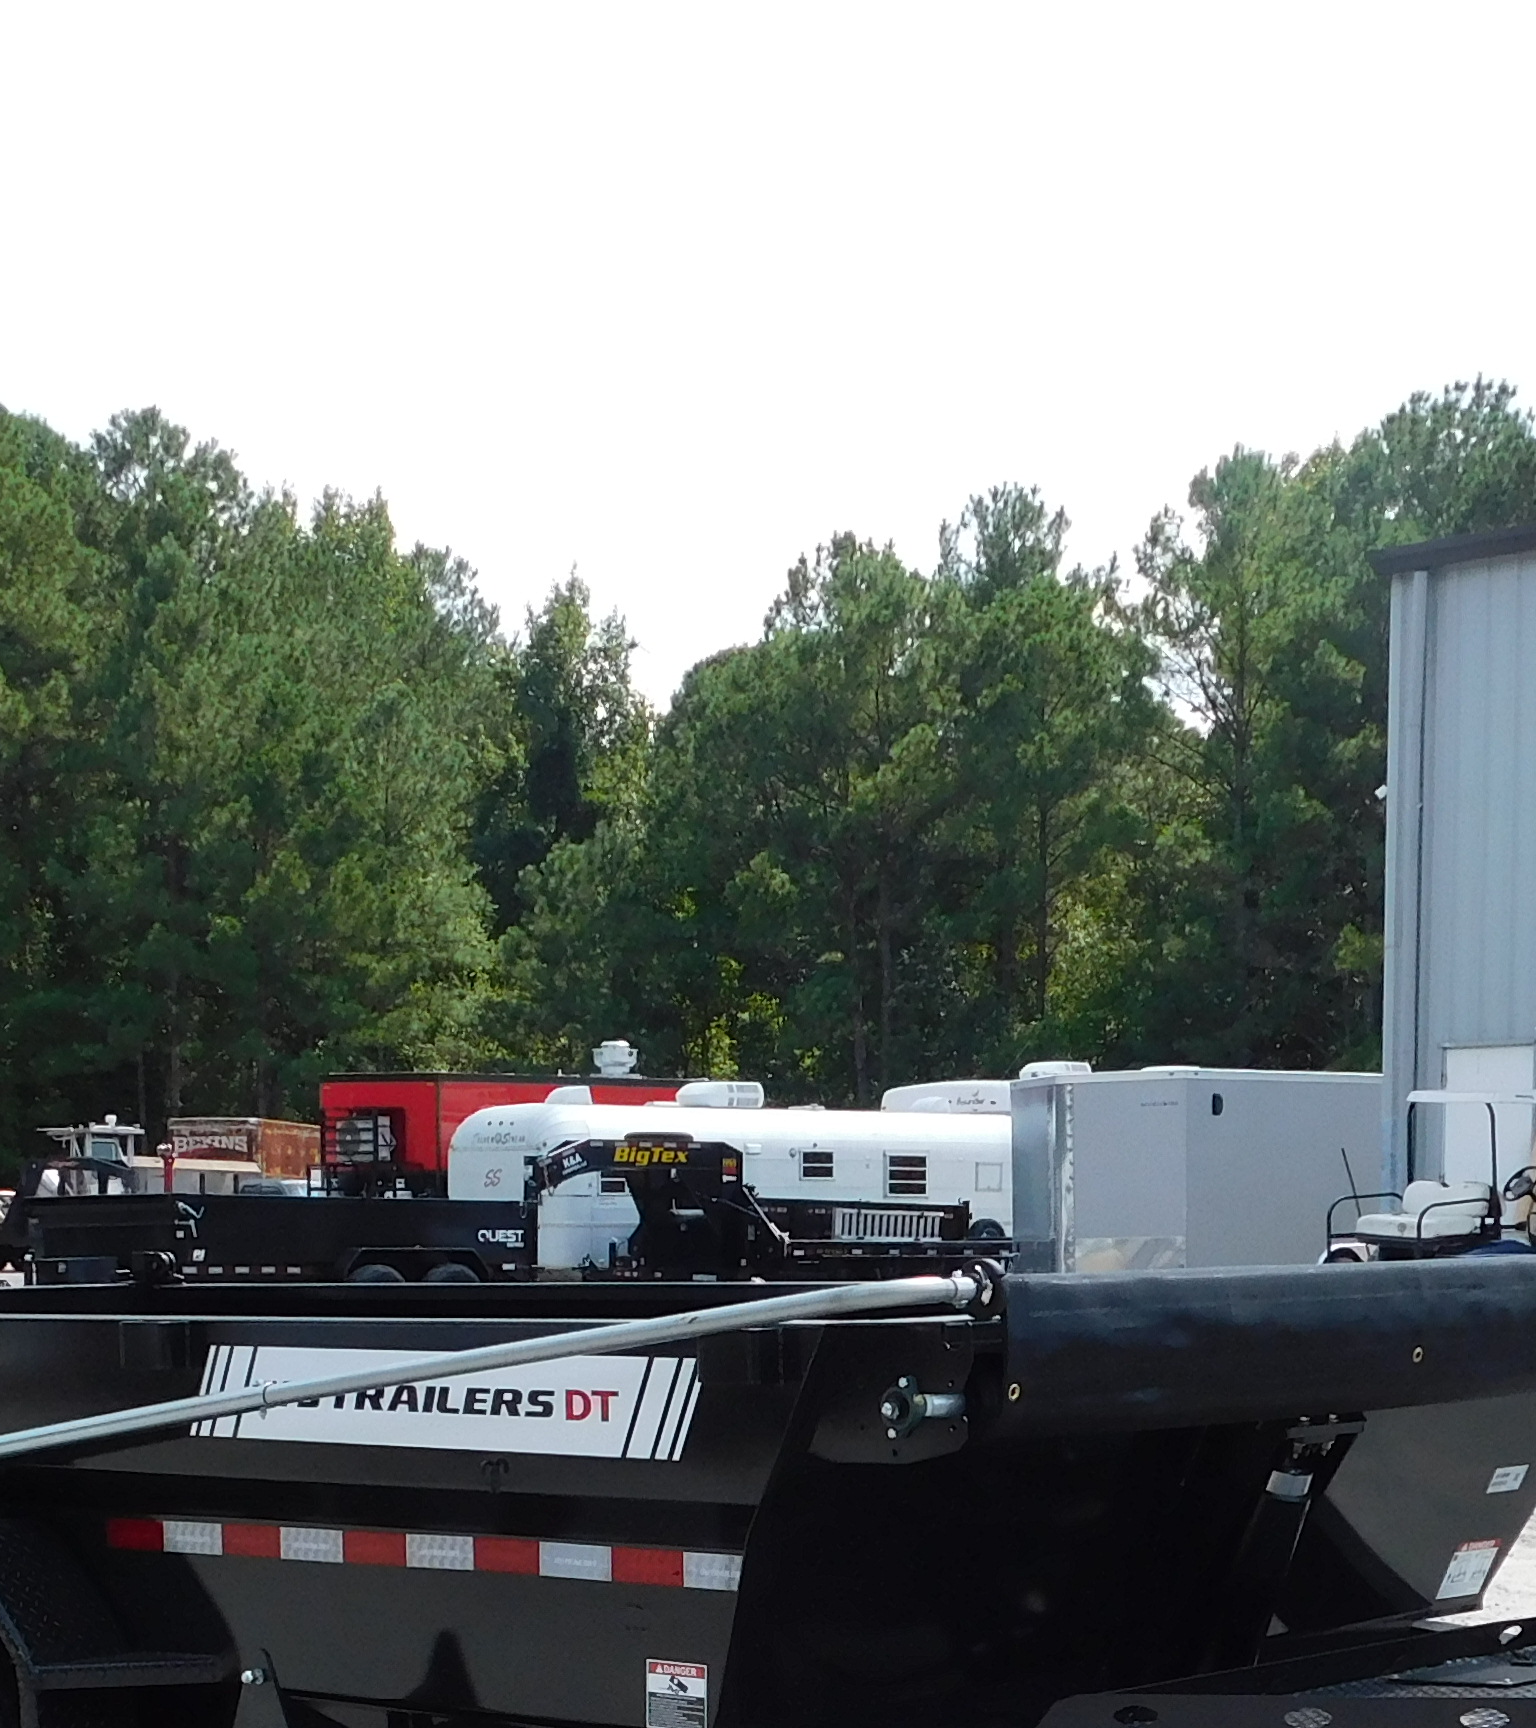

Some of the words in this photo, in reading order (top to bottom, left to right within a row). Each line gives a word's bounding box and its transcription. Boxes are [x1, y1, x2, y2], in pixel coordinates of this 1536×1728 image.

[477, 1229, 524, 1242] QUEST
[268, 1381, 555, 1417] RAILERS
[565, 1389, 619, 1422] DT
[664, 1665, 697, 1677] DANGER
